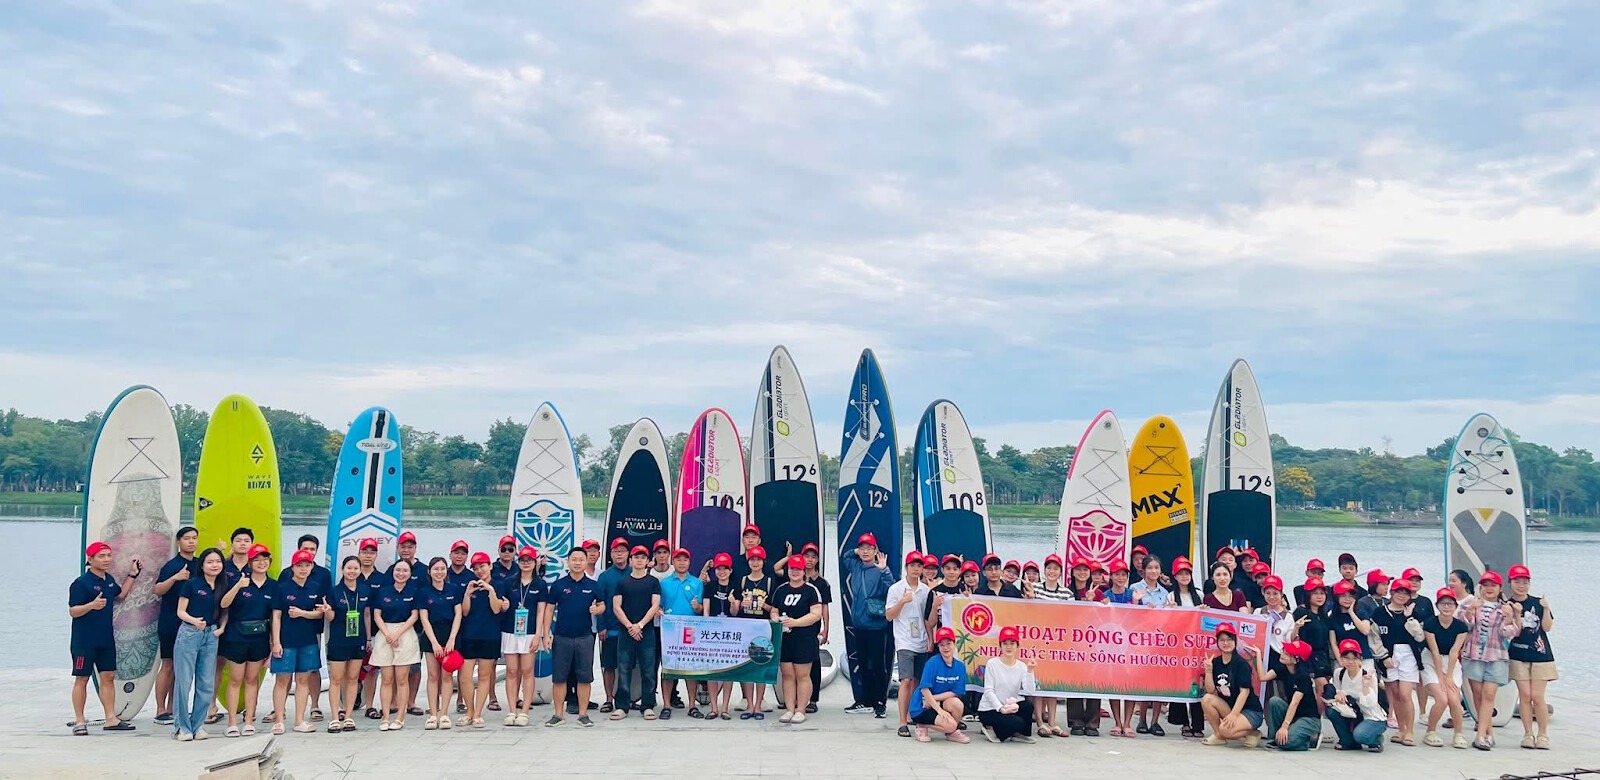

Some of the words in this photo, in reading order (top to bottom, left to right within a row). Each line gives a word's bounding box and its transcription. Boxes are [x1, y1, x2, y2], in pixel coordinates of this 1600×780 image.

[708, 429, 716, 474] GLADIATOR
[941, 423, 950, 467] GLADIATOR
[616, 520, 646, 530] WAVE
[647, 522, 663, 530] FIT
[784, 594, 801, 606] 07
[1014, 625, 1067, 645] HOẠT
[1072, 625, 1123, 648] ĐỘNG
[1128, 628, 1178, 648] CHÈO
[1184, 634, 1216, 649] SUP
[1020, 645, 1046, 660] RÁC
[1050, 648, 1085, 662] TRÊN
[1090, 650, 1126, 664] SÔNG
[1130, 654, 1177, 667] HƯƠNG
